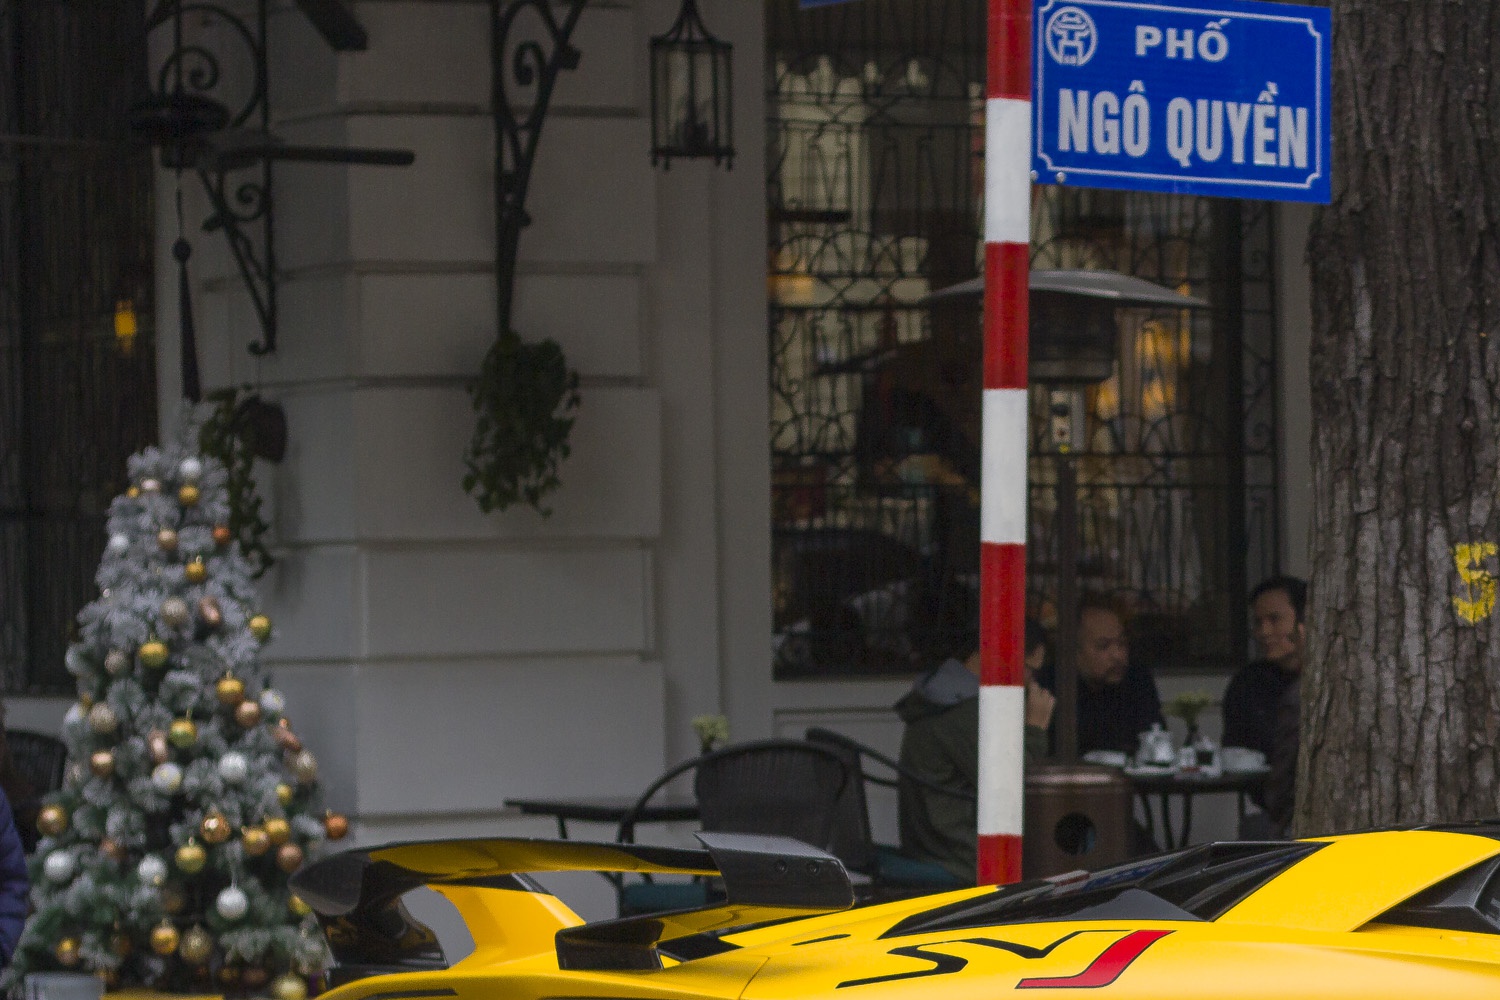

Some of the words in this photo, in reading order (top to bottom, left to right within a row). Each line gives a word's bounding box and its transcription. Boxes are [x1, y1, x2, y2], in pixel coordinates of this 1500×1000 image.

[1135, 17, 1232, 62] PHỐ
[1058, 79, 1150, 158] NGÔ
[1166, 81, 1308, 169] QUYỀN
[836, 930, 1176, 989] SVJ
